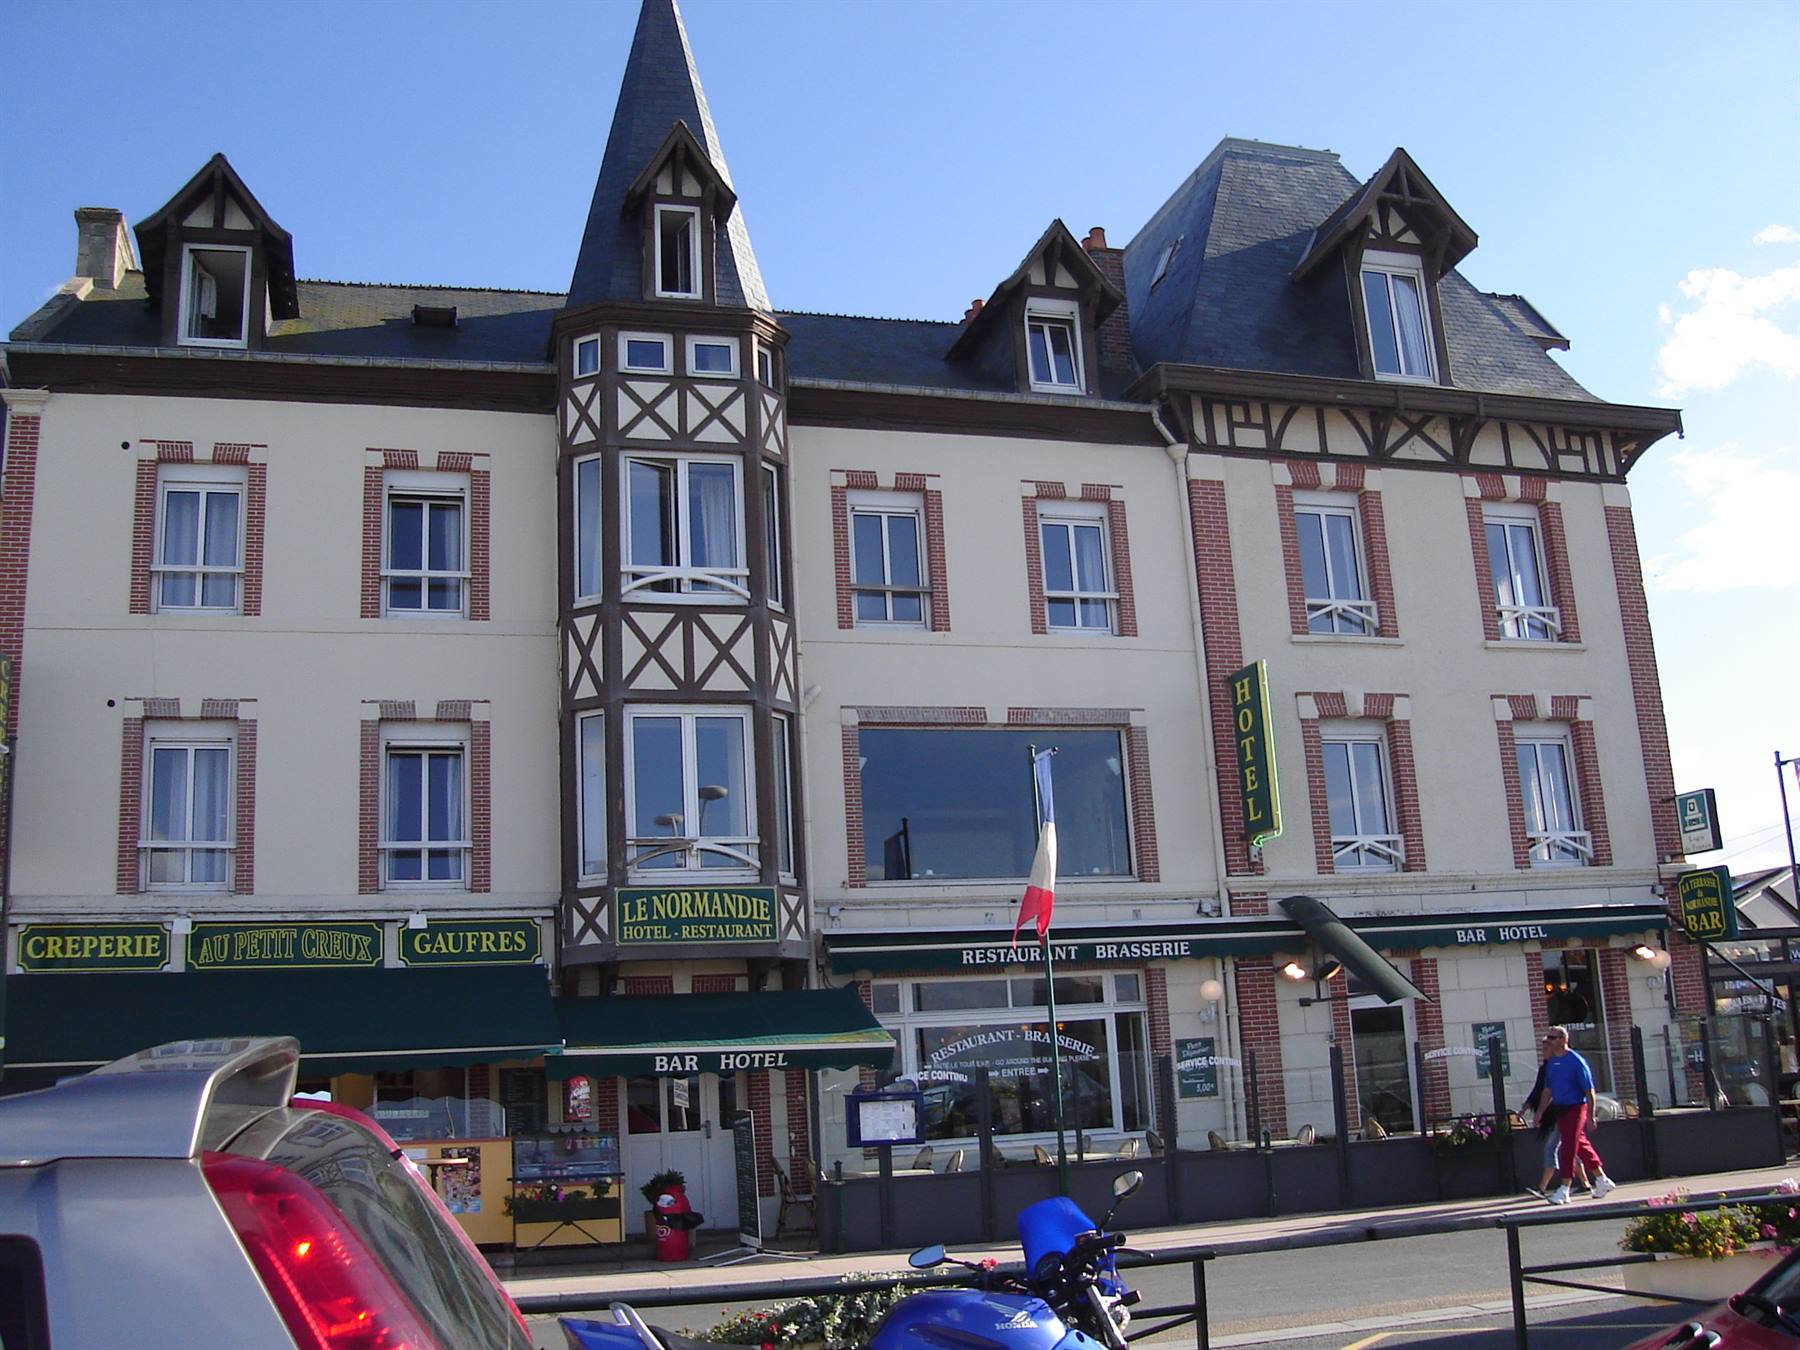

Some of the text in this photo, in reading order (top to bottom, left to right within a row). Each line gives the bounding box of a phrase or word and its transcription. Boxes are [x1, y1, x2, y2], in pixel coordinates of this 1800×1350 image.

[1234, 677, 1262, 822] HOTEL
[623, 892, 771, 923] LE NORMANDIE
[623, 923, 772, 939] HOTEL RESTAURANT
[1686, 911, 1722, 932] BAR
[414, 930, 527, 954] GAUFRES
[1456, 925, 1547, 942] BAR HOTEL
[26, 935, 161, 959] CREPERIE
[199, 928, 373, 964] AU PETIT CREUX
[1096, 941, 1190, 958] BRASSERIE
[931, 1029, 1095, 1064] RESTAURANT BRASERIE
[655, 1052, 788, 1072] BAR HOTEL
[1177, 1056, 1208, 1071] SERVICE
[930, 1070, 968, 1083] CONTINU
[994, 1321, 1038, 1330] HONDA
